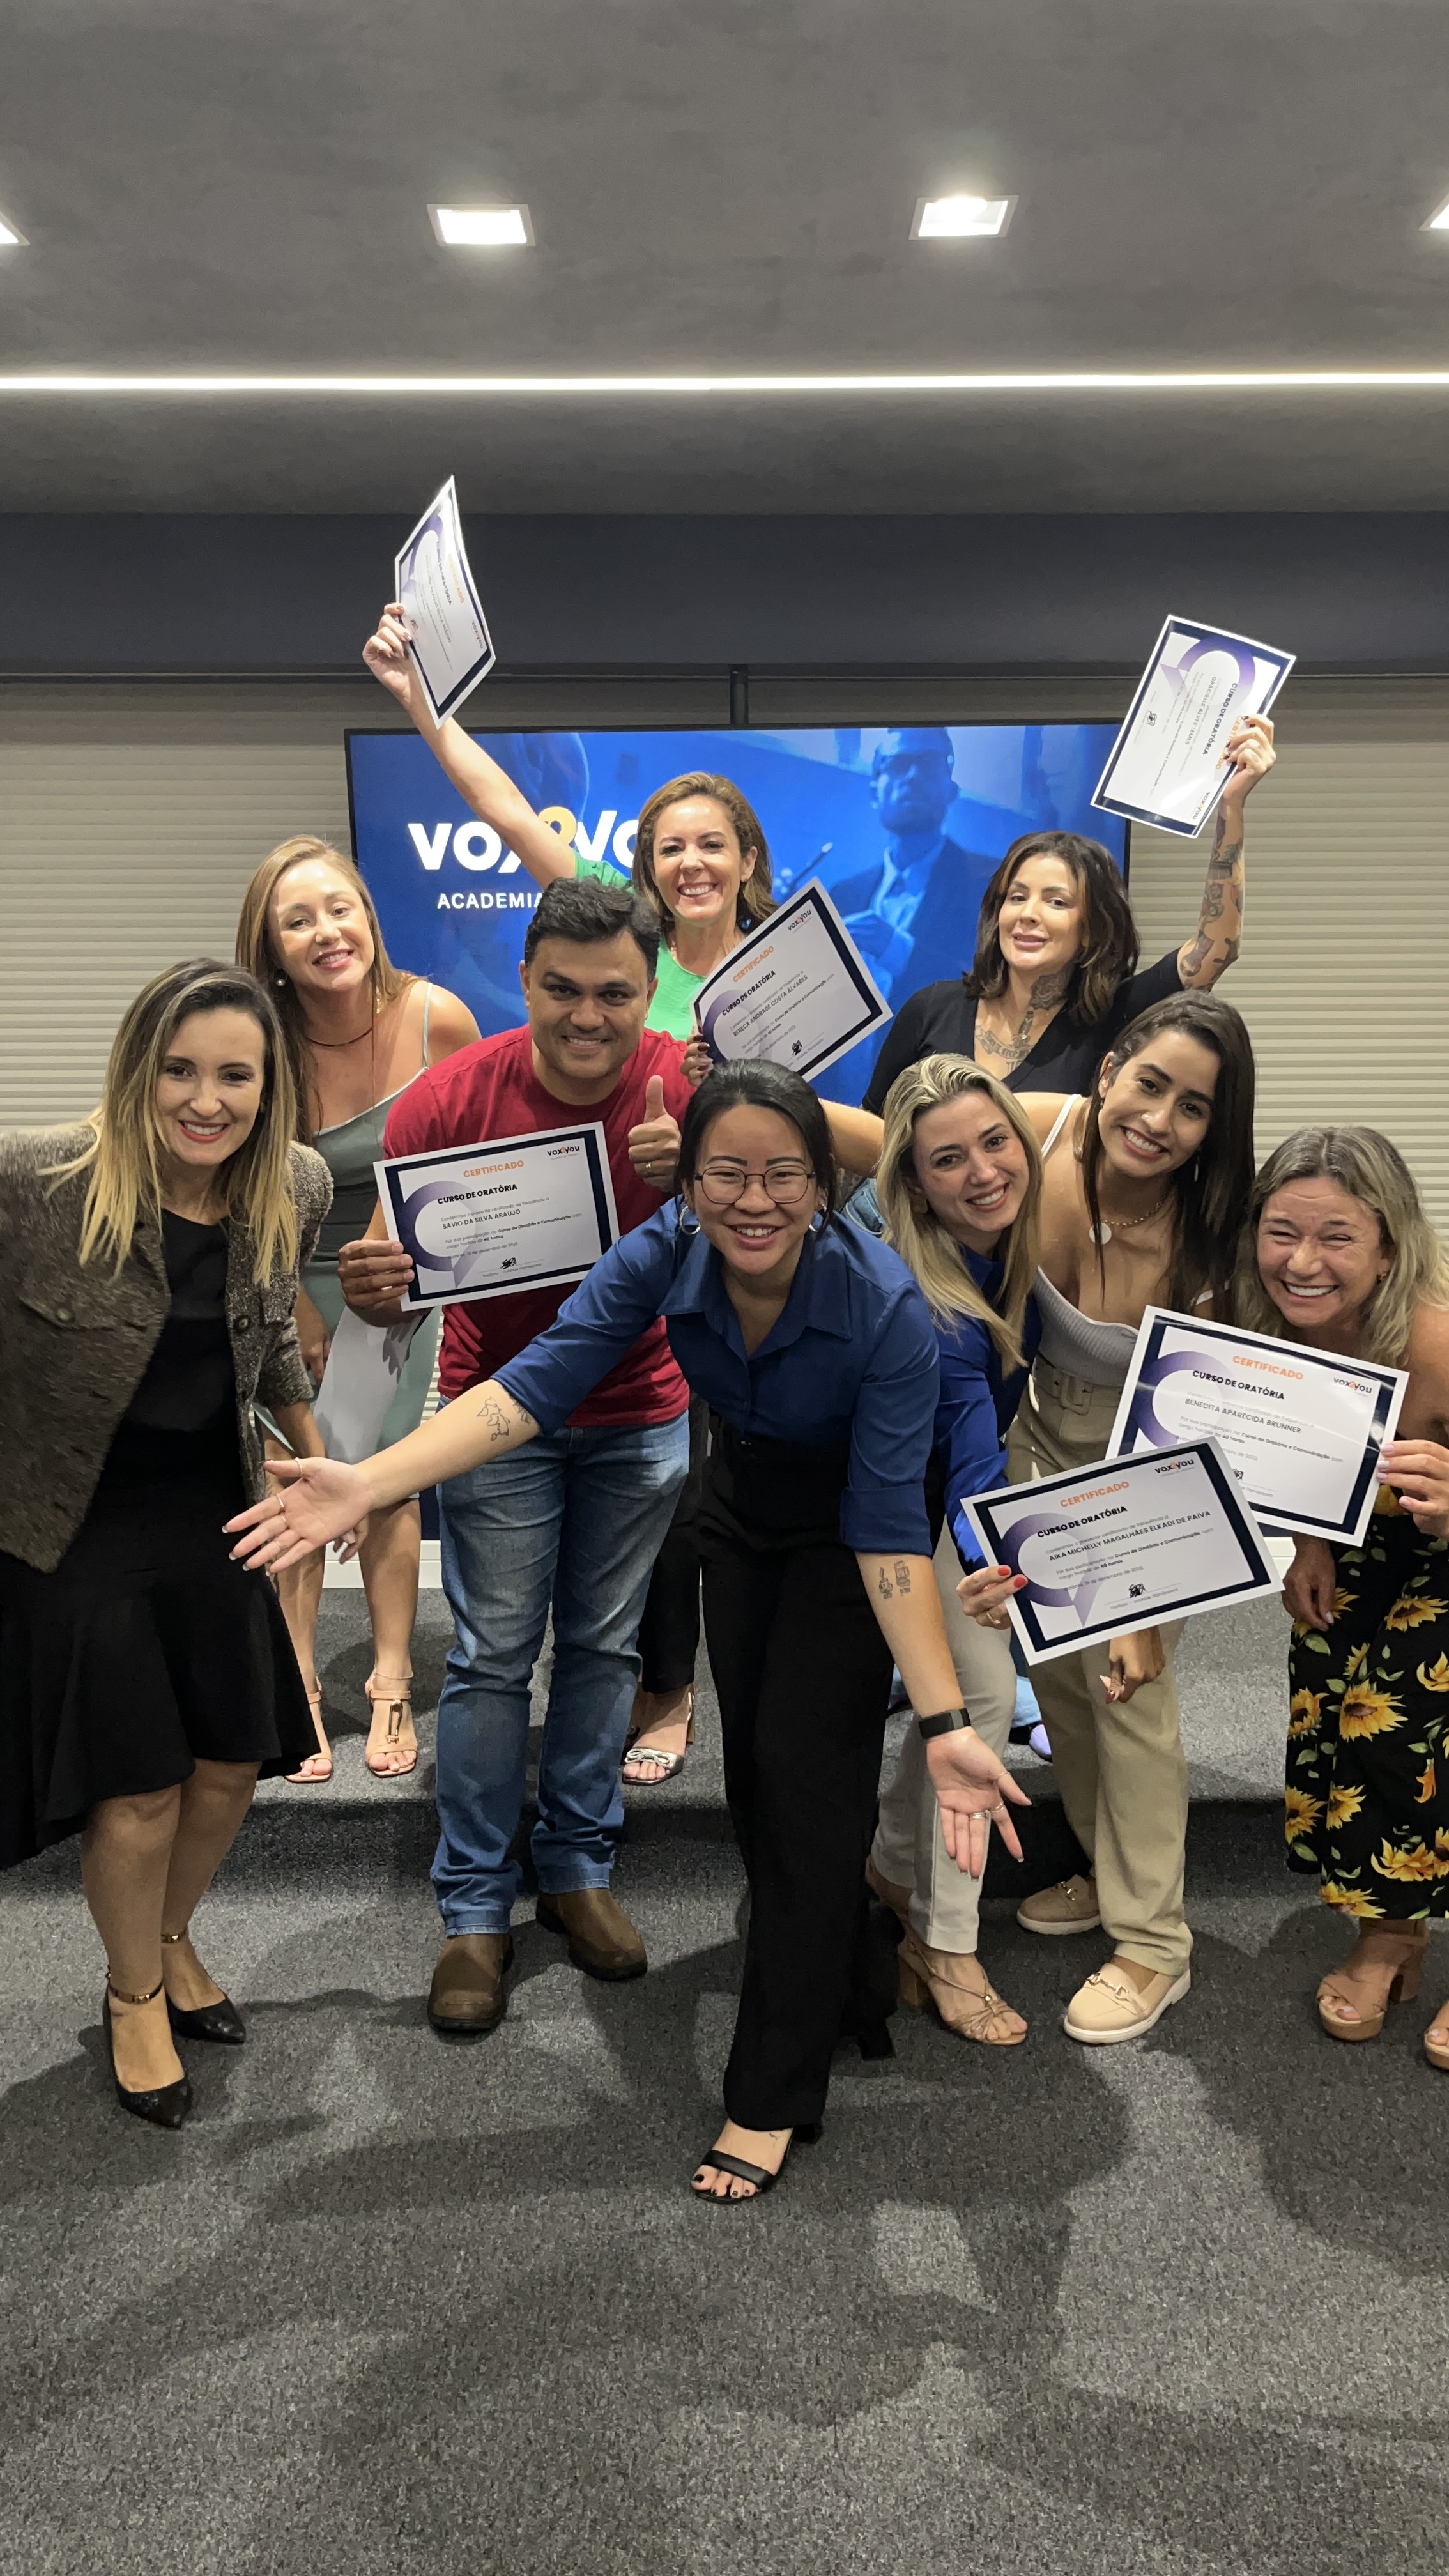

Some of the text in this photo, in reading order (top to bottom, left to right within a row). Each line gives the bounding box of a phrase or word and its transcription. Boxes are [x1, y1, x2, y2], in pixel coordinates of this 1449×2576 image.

[1200, 682, 1238, 755] CURSO DE ORATÓRIA
[731, 945, 776, 983] CERTIFICADO
[720, 969, 776, 1016] CURSO DE ORATÓRIA
[732, 1021, 750, 1037] REBECA
[749, 1004, 772, 1023] ANDRADE
[770, 991, 787, 1006] COSTA
[463, 1160, 524, 1177] CERTIFICADO
[437, 1193, 464, 1204] CURSO
[476, 1182, 518, 1197] ORATÓRIA
[475, 1214, 493, 1222] SILVA
[1192, 1370, 1285, 1400] CURSO DE ORATÓRIA
[1232, 1354, 1304, 1381] CERTIFICADO
[1184, 1398, 1301, 1433] BENEDITA APARECIDA BRUNNER
[1058, 1480, 1131, 1508] CERTIFICADO
[1036, 1503, 1128, 1538] CURSO DE ORATÓRIA
[1048, 1551, 1067, 1561] AIKA
[1066, 1540, 1102, 1555] MICHELLY
[1101, 1526, 1149, 1545] MAGALHÃES
[1149, 1519, 1176, 1531] ELKADI
[1186, 1510, 1210, 1521] PAIVA
